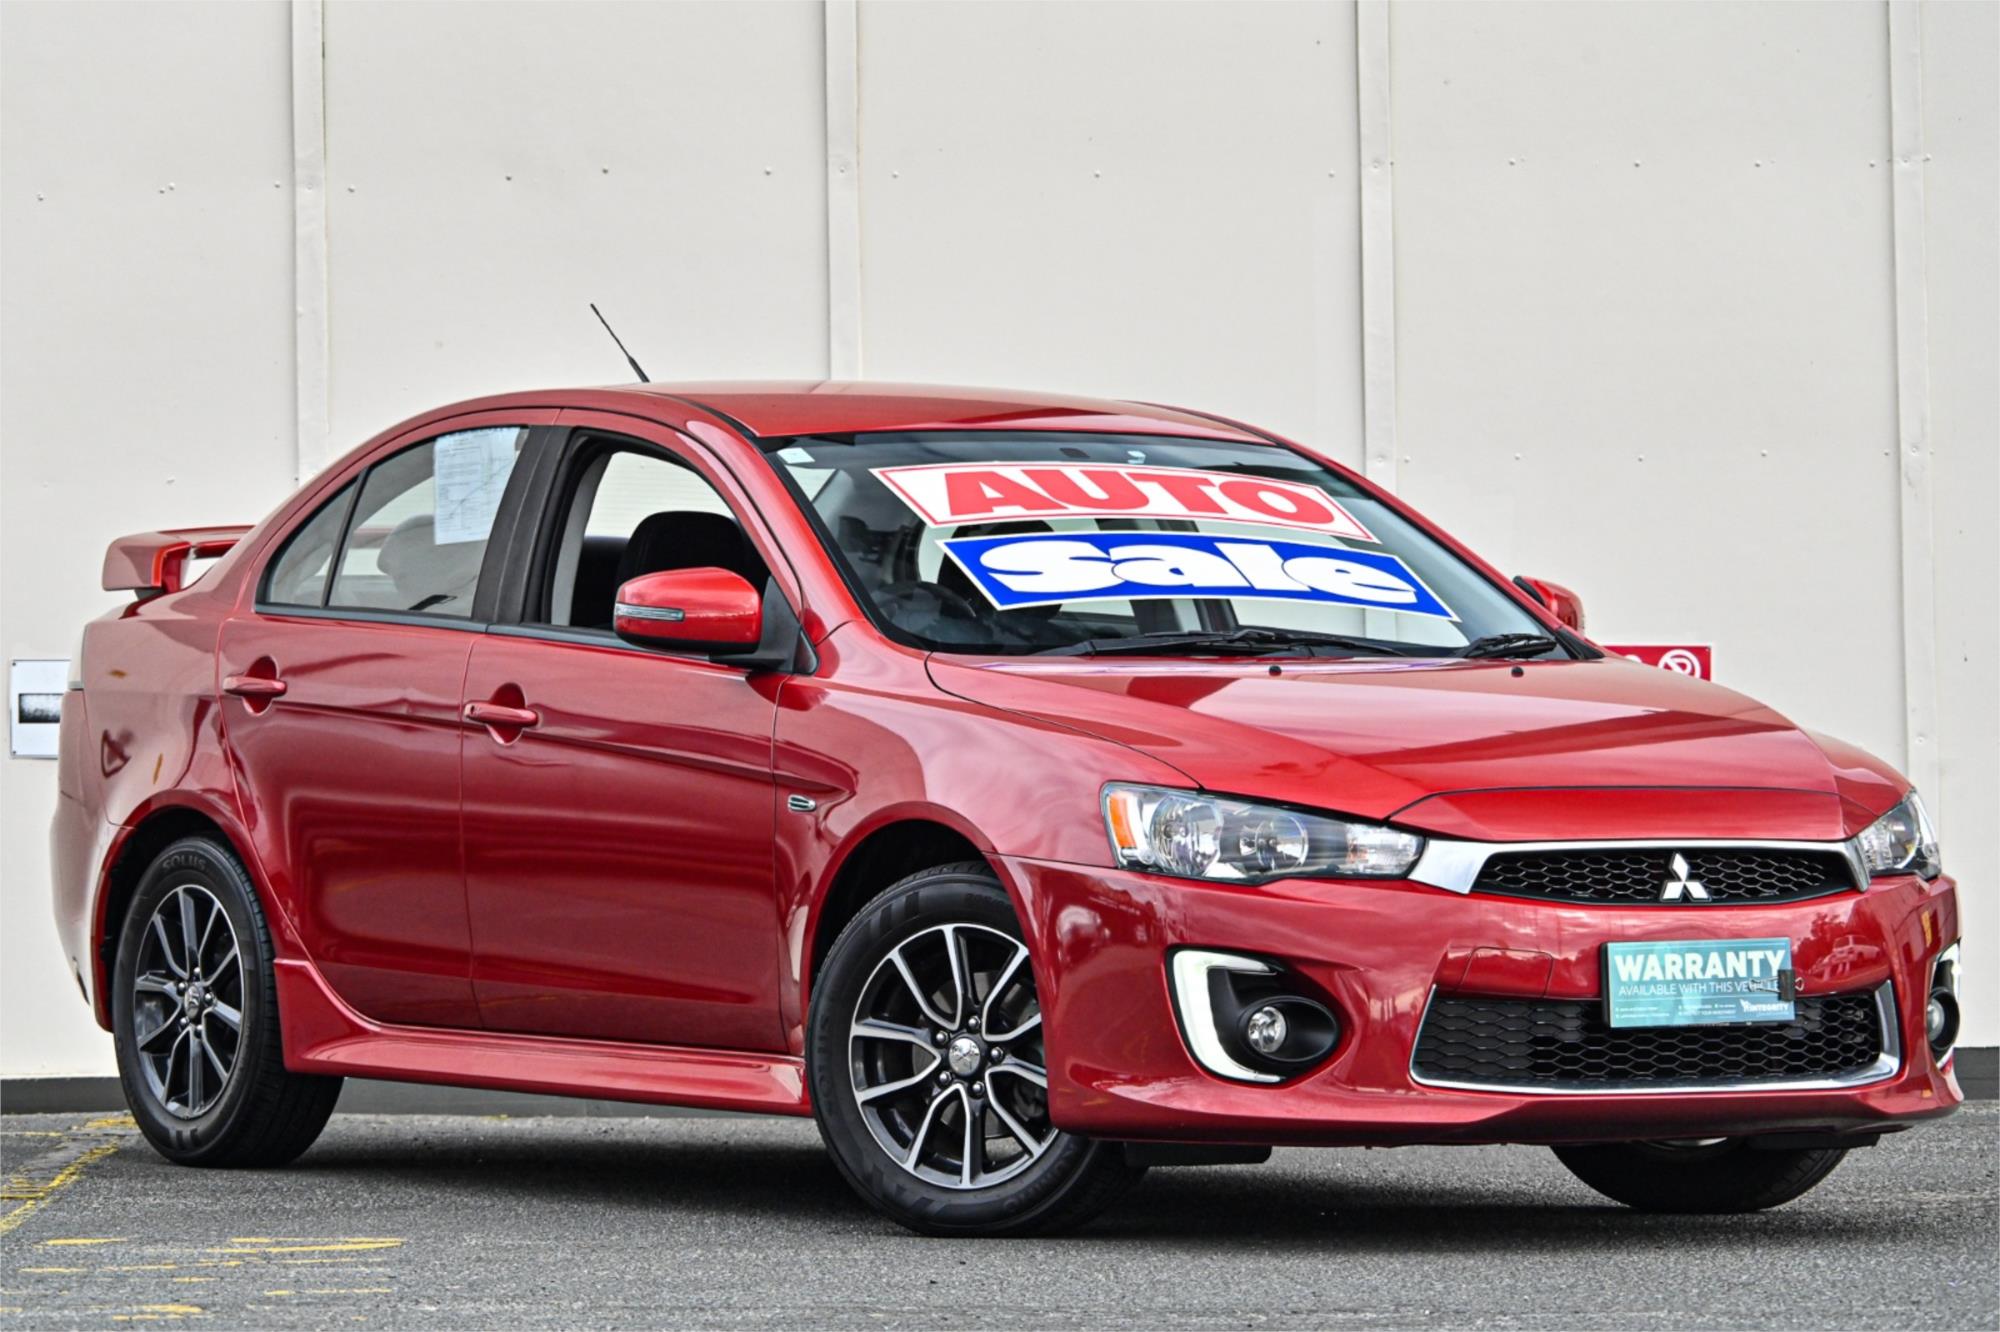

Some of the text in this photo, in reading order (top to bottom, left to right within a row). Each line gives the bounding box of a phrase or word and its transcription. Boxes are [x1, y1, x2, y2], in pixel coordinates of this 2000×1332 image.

[945, 469, 1335, 524] AUTO
[980, 540, 1418, 604] Sale
[162, 854, 207, 872] SOLUS
[1614, 949, 1786, 982] WARRANTY
[1619, 984, 1677, 996] AVAILABLE
[1679, 982, 1707, 994] WITH
[1709, 981, 1733, 993] THIS
